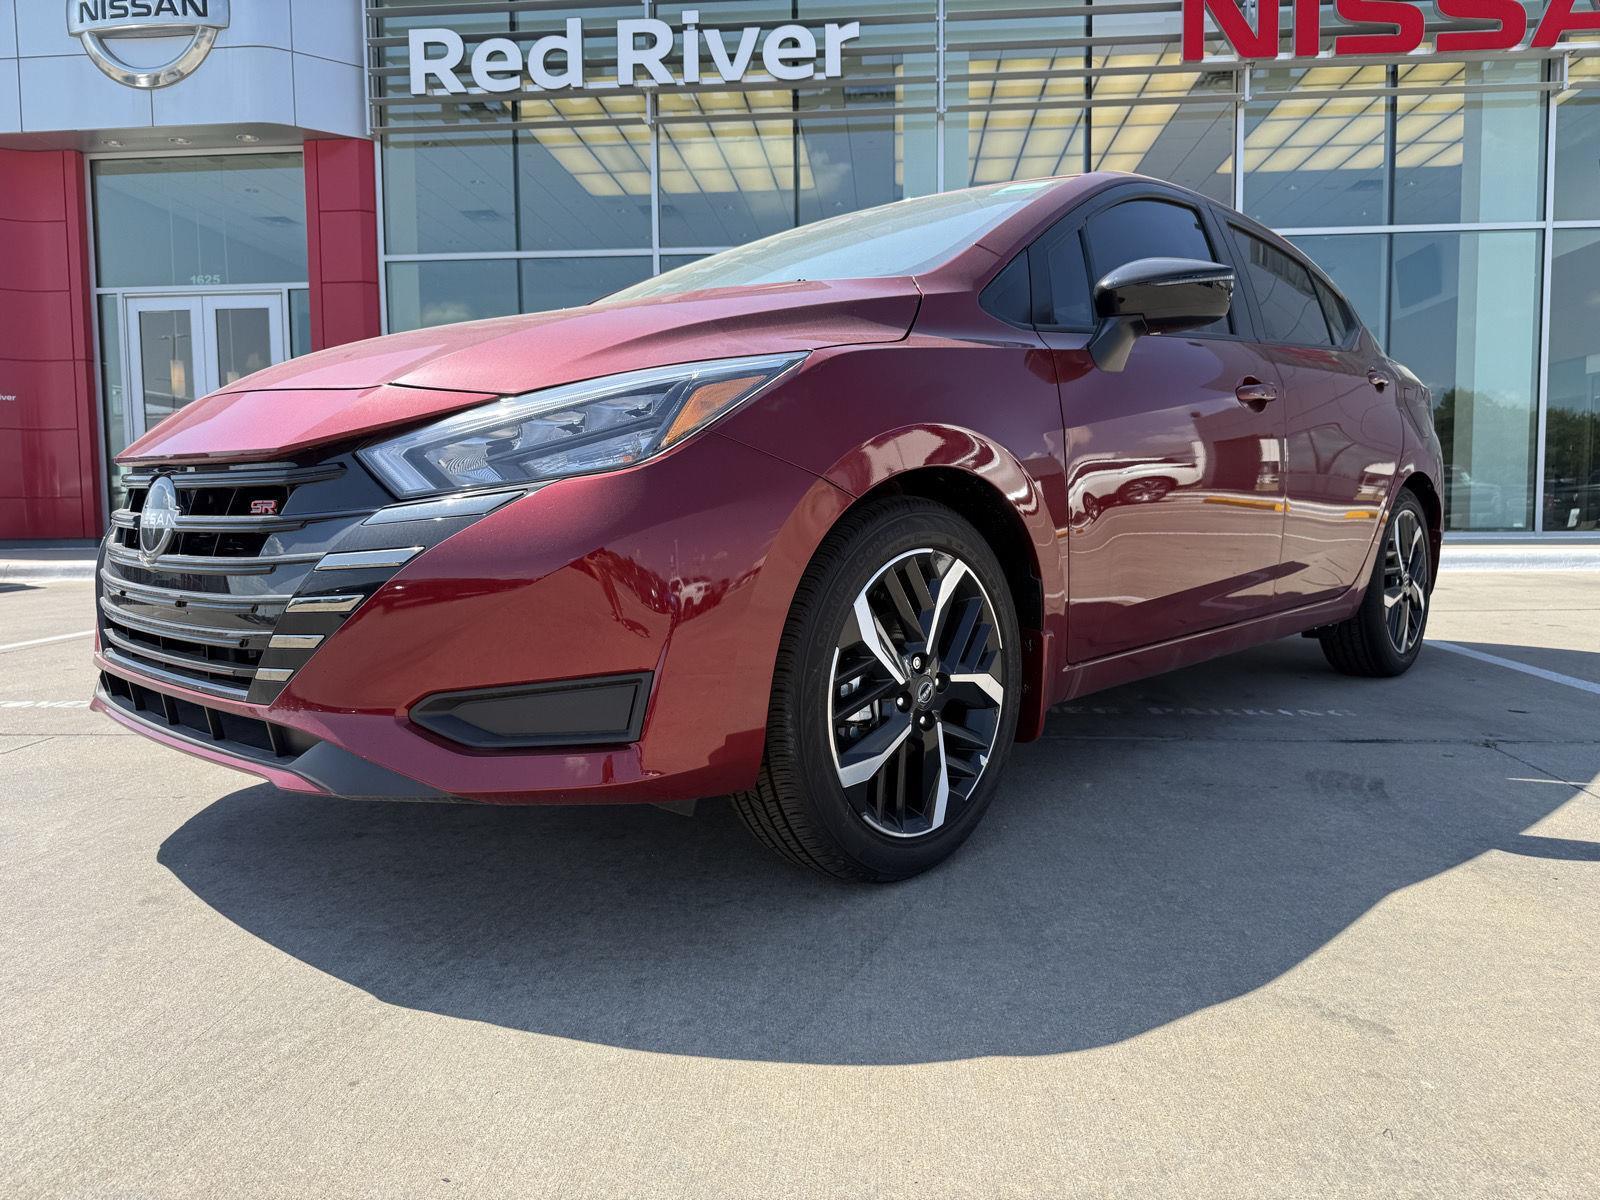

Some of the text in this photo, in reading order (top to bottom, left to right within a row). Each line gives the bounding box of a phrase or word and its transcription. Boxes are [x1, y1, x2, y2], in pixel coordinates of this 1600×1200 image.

[79, 0, 208, 23] NISSAN
[408, 10, 860, 95] Red River
[190, 274, 221, 285] 1625
[250, 499, 277, 514] SR
